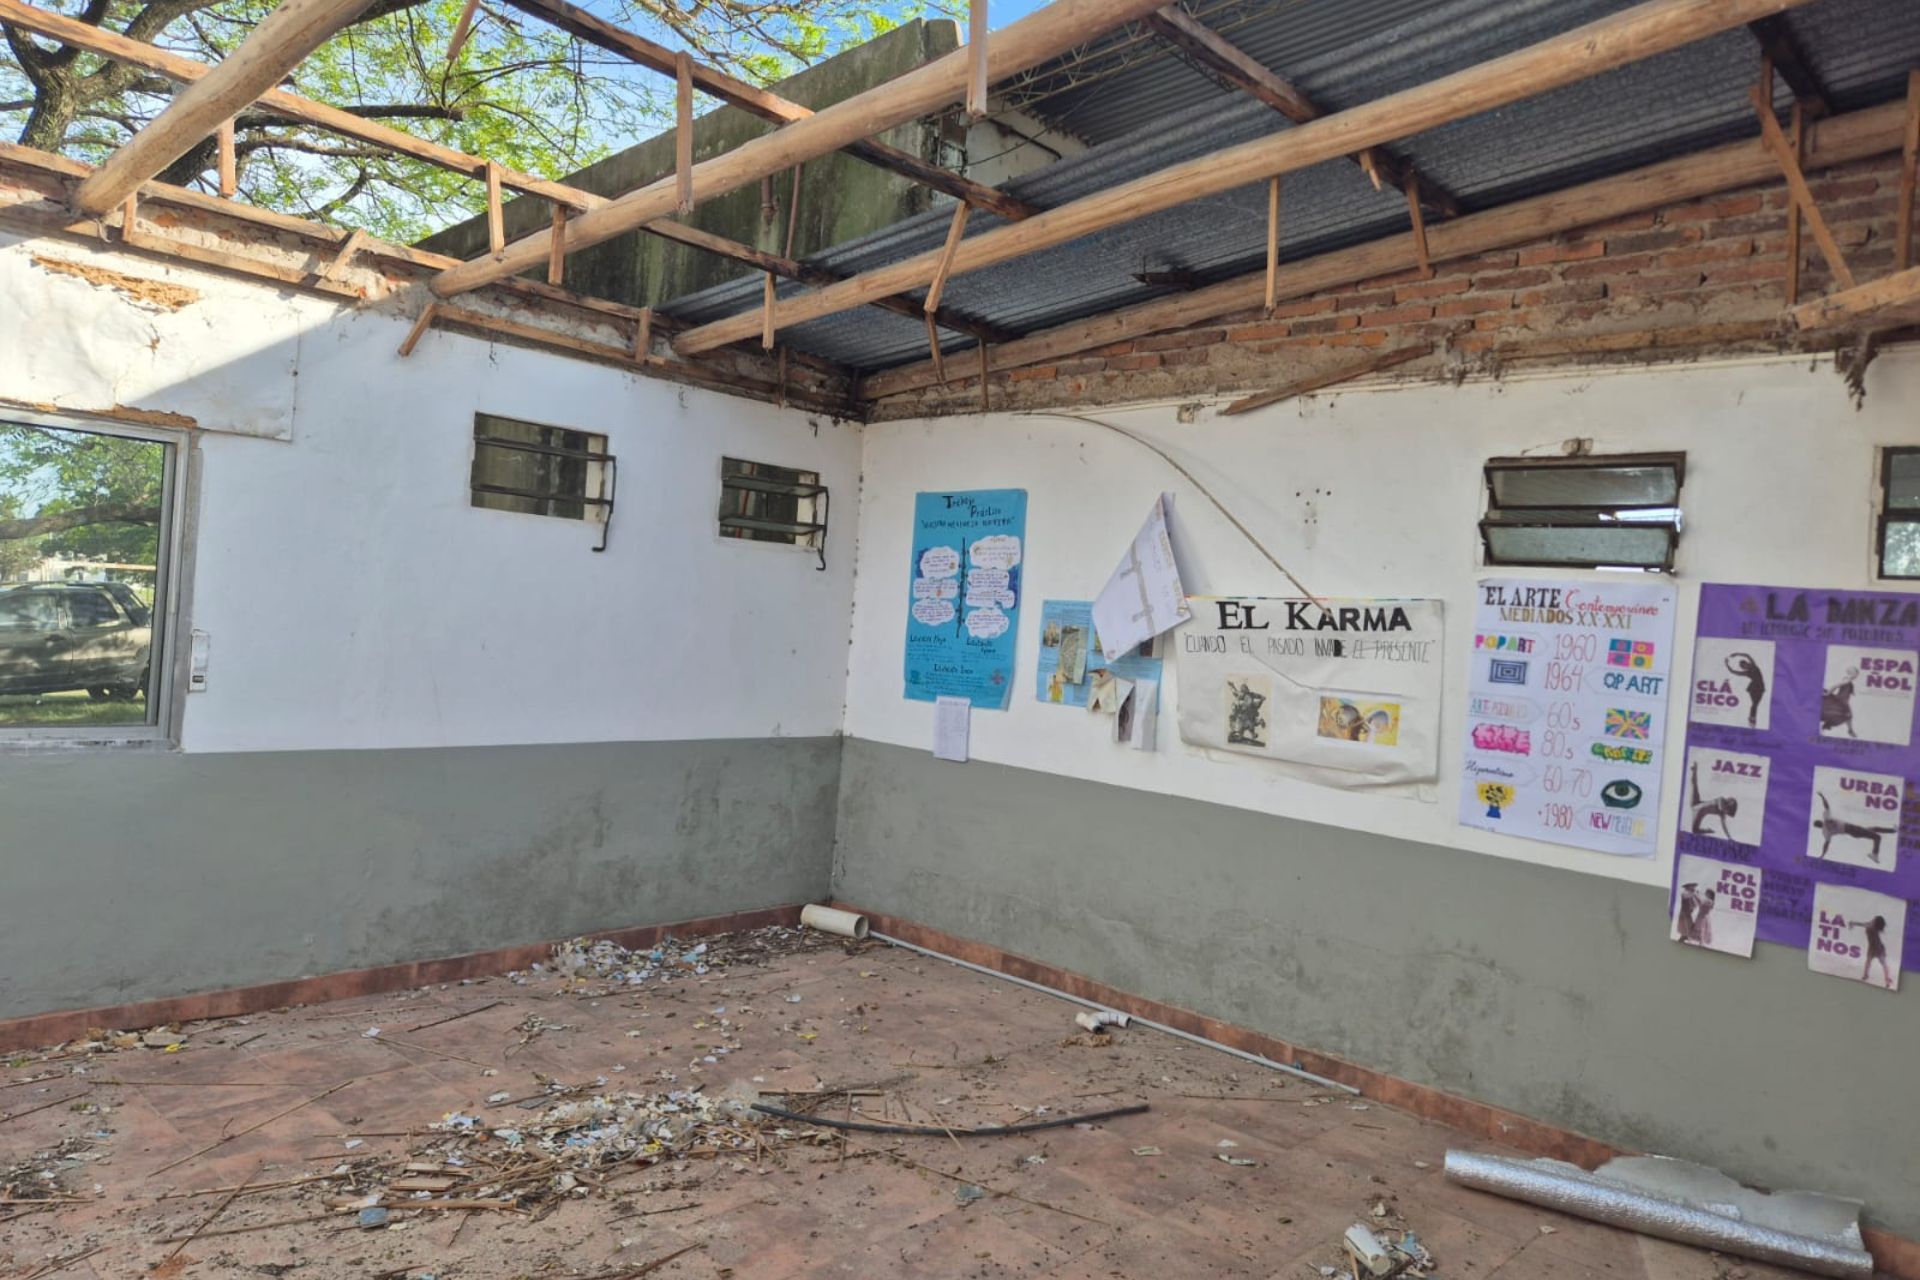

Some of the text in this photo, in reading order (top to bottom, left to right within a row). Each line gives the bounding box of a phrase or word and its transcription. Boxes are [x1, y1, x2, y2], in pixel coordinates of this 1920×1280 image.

[1510, 588, 1562, 608] ARTE
[1766, 592, 1809, 622] LA
[1216, 601, 1412, 632] EL KARMA
[1475, 634, 1536, 653] POP ART
[1553, 633, 1597, 662] 1960
[1860, 657, 1914, 674] ESPA
[1543, 661, 1584, 692] 1964
[1625, 675, 1664, 695] ART
[1866, 671, 1913, 691] ÑOL
[1696, 679, 1733, 694] CLÁ
[1695, 693, 1740, 707] SICO
[1711, 759, 1762, 778] JAZZ
[1840, 777, 1899, 798] URBA
[1865, 796, 1898, 811] NO
[1722, 869, 1757, 887] FOL
[1716, 881, 1756, 899] KLO
[1730, 898, 1755, 913] RE
[1819, 911, 1846, 928] LA
[1819, 925, 1840, 940] TI
[1816, 937, 1862, 958] NOS
